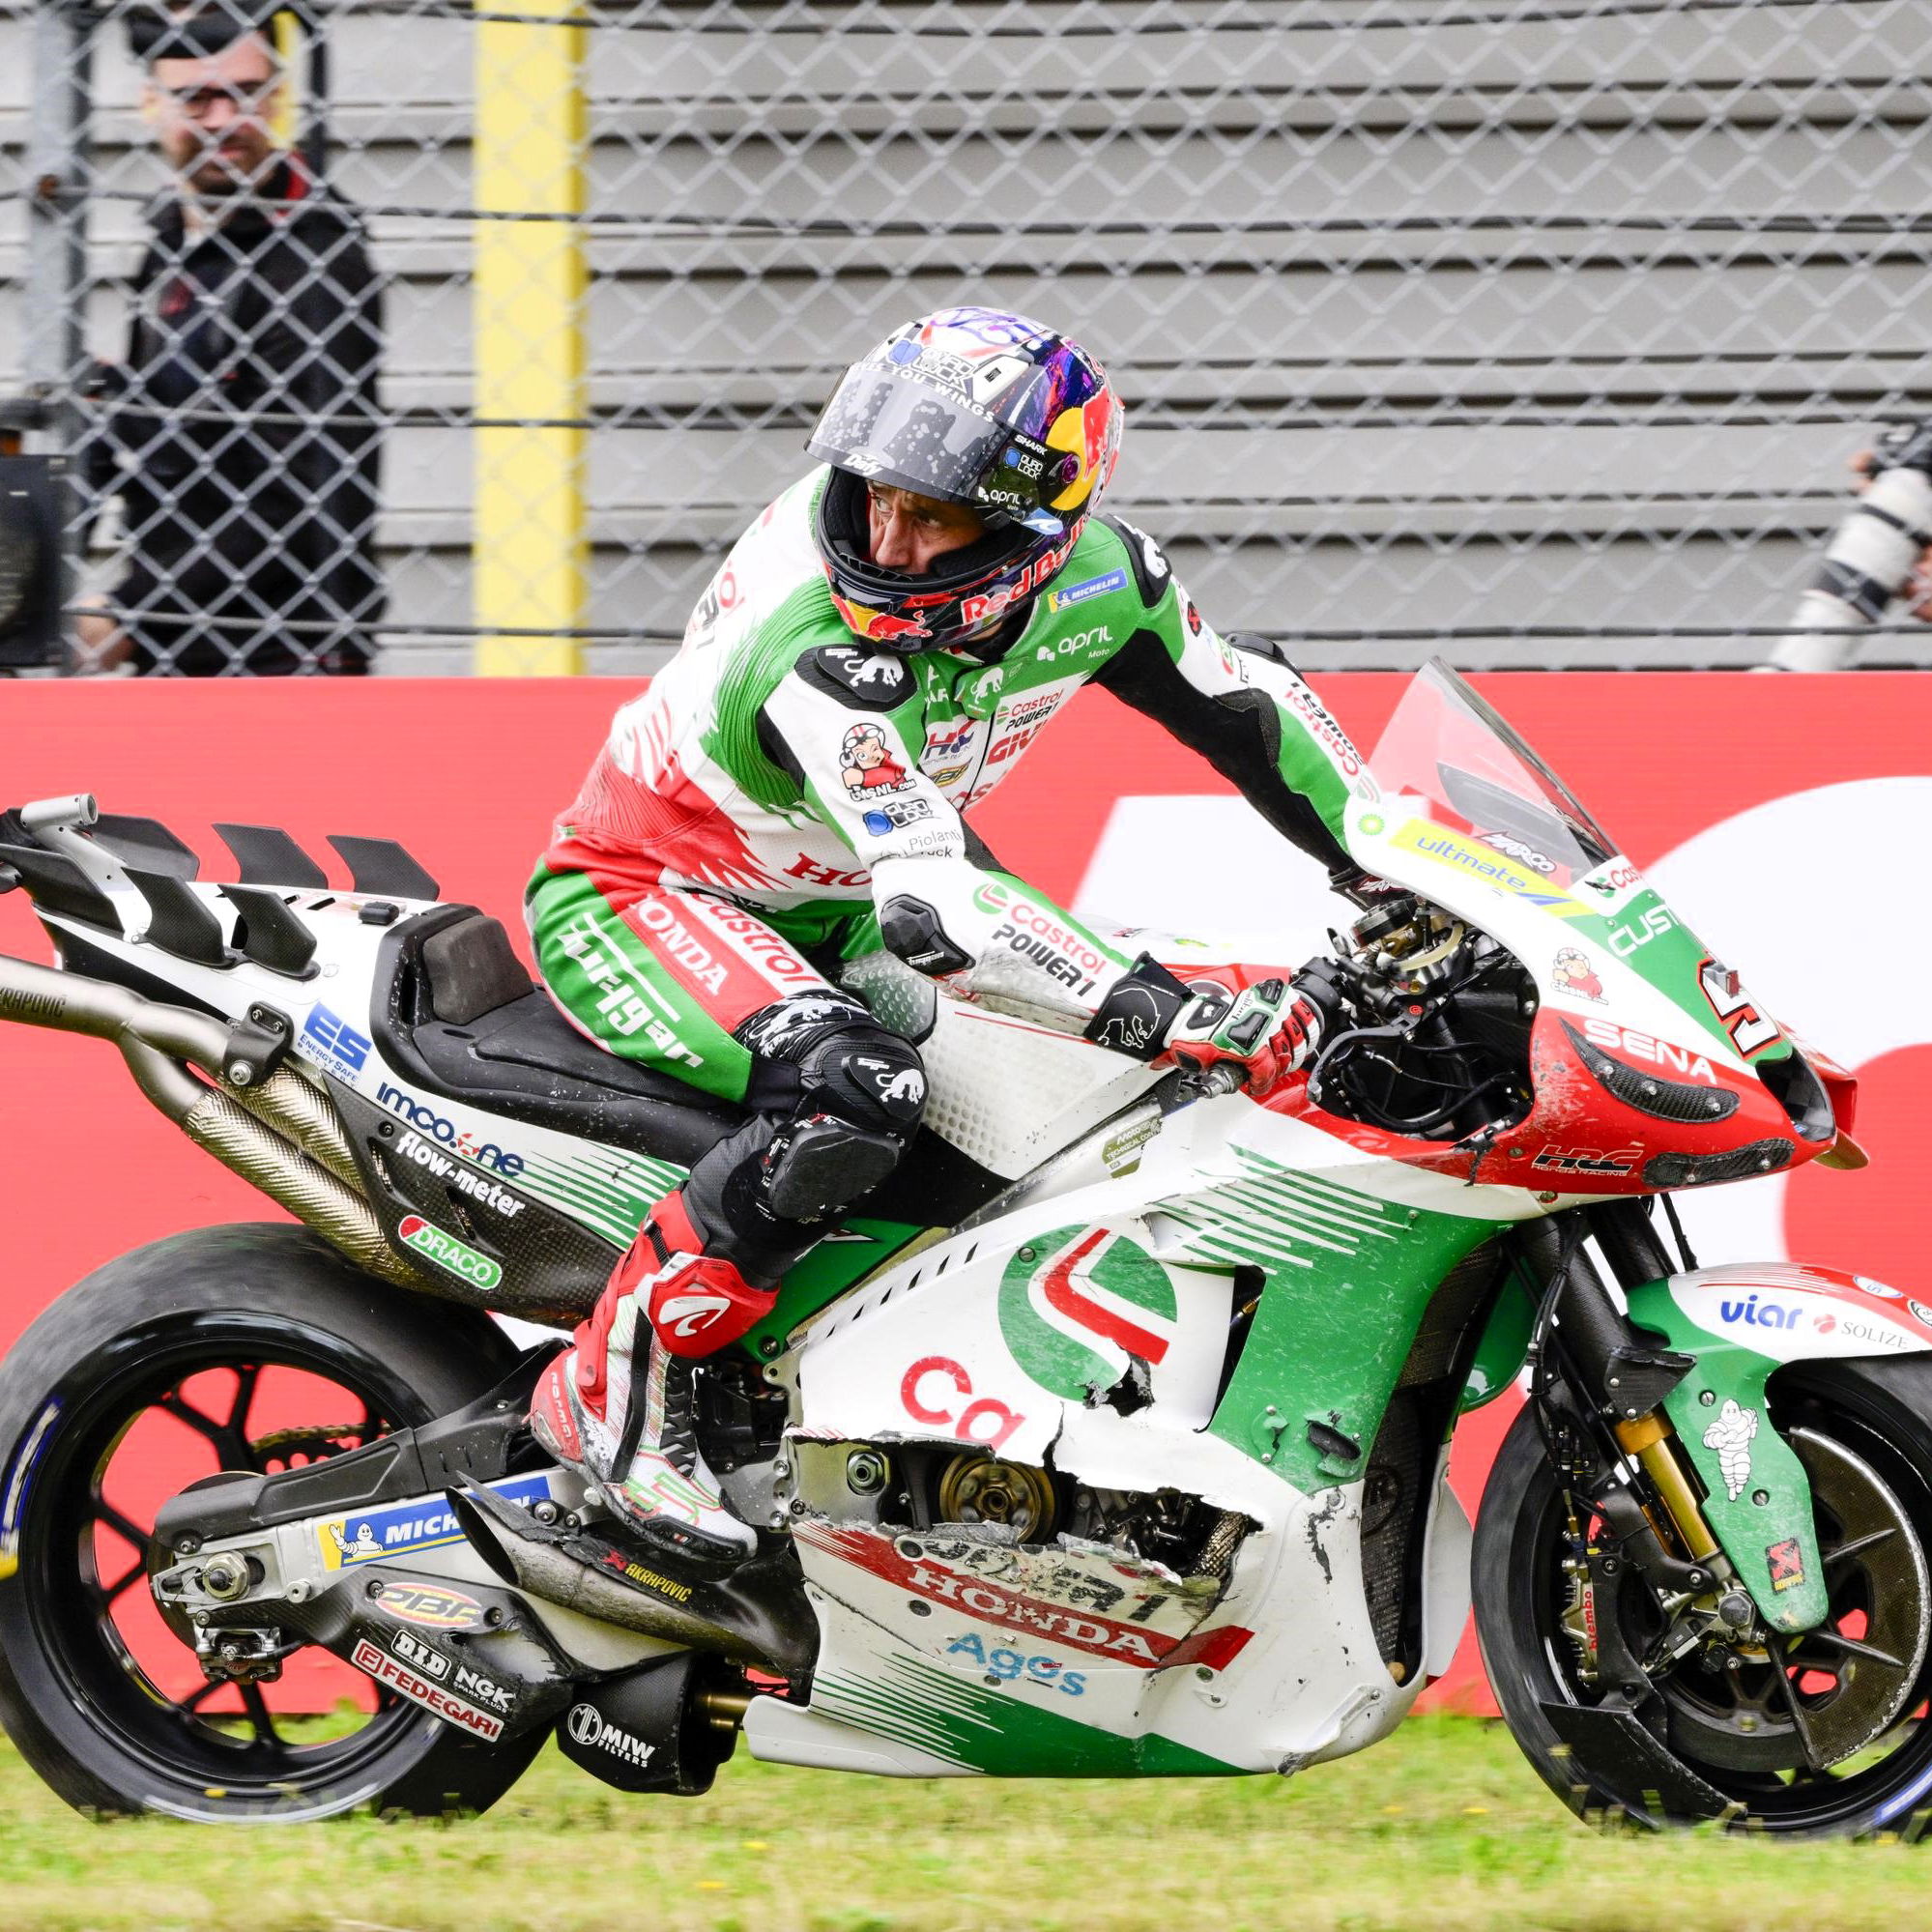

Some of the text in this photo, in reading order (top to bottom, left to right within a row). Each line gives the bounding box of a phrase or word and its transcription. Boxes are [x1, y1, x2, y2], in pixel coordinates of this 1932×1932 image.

[934, 382, 995, 422] WINGS
[1015, 435, 1048, 455] SHARK
[1018, 463, 1041, 479] LOCK
[990, 489, 1020, 504] april
[961, 565, 1031, 625] Red
[1072, 577, 1120, 599] MICHELIN
[1058, 625, 1113, 655] april
[1088, 649, 1110, 658] Moto
[1012, 689, 1064, 716] Castrol
[1417, 836, 1526, 890] ultimate
[1011, 904, 1109, 975] Castrol
[991, 924, 1097, 996] POWER1
[303, 1001, 372, 1072] ES
[1584, 1019, 1717, 1085] SENA
[395, 1132, 526, 1218] flow-meter
[1532, 1144, 1643, 1172] HRC
[415, 1222, 493, 1282] DRACO
[1719, 1292, 1803, 1332] viar
[1841, 1321, 1908, 1350] SOLIZE
[906, 1563, 1161, 1662] HONDA
[1581, 1591, 1599, 1651] brembo
[382, 1660, 500, 1738] FEDEGARI
[455, 1666, 516, 1709] NGK
[598, 1739, 649, 1768] FILTERS
[601, 1723, 656, 1760] MIW
